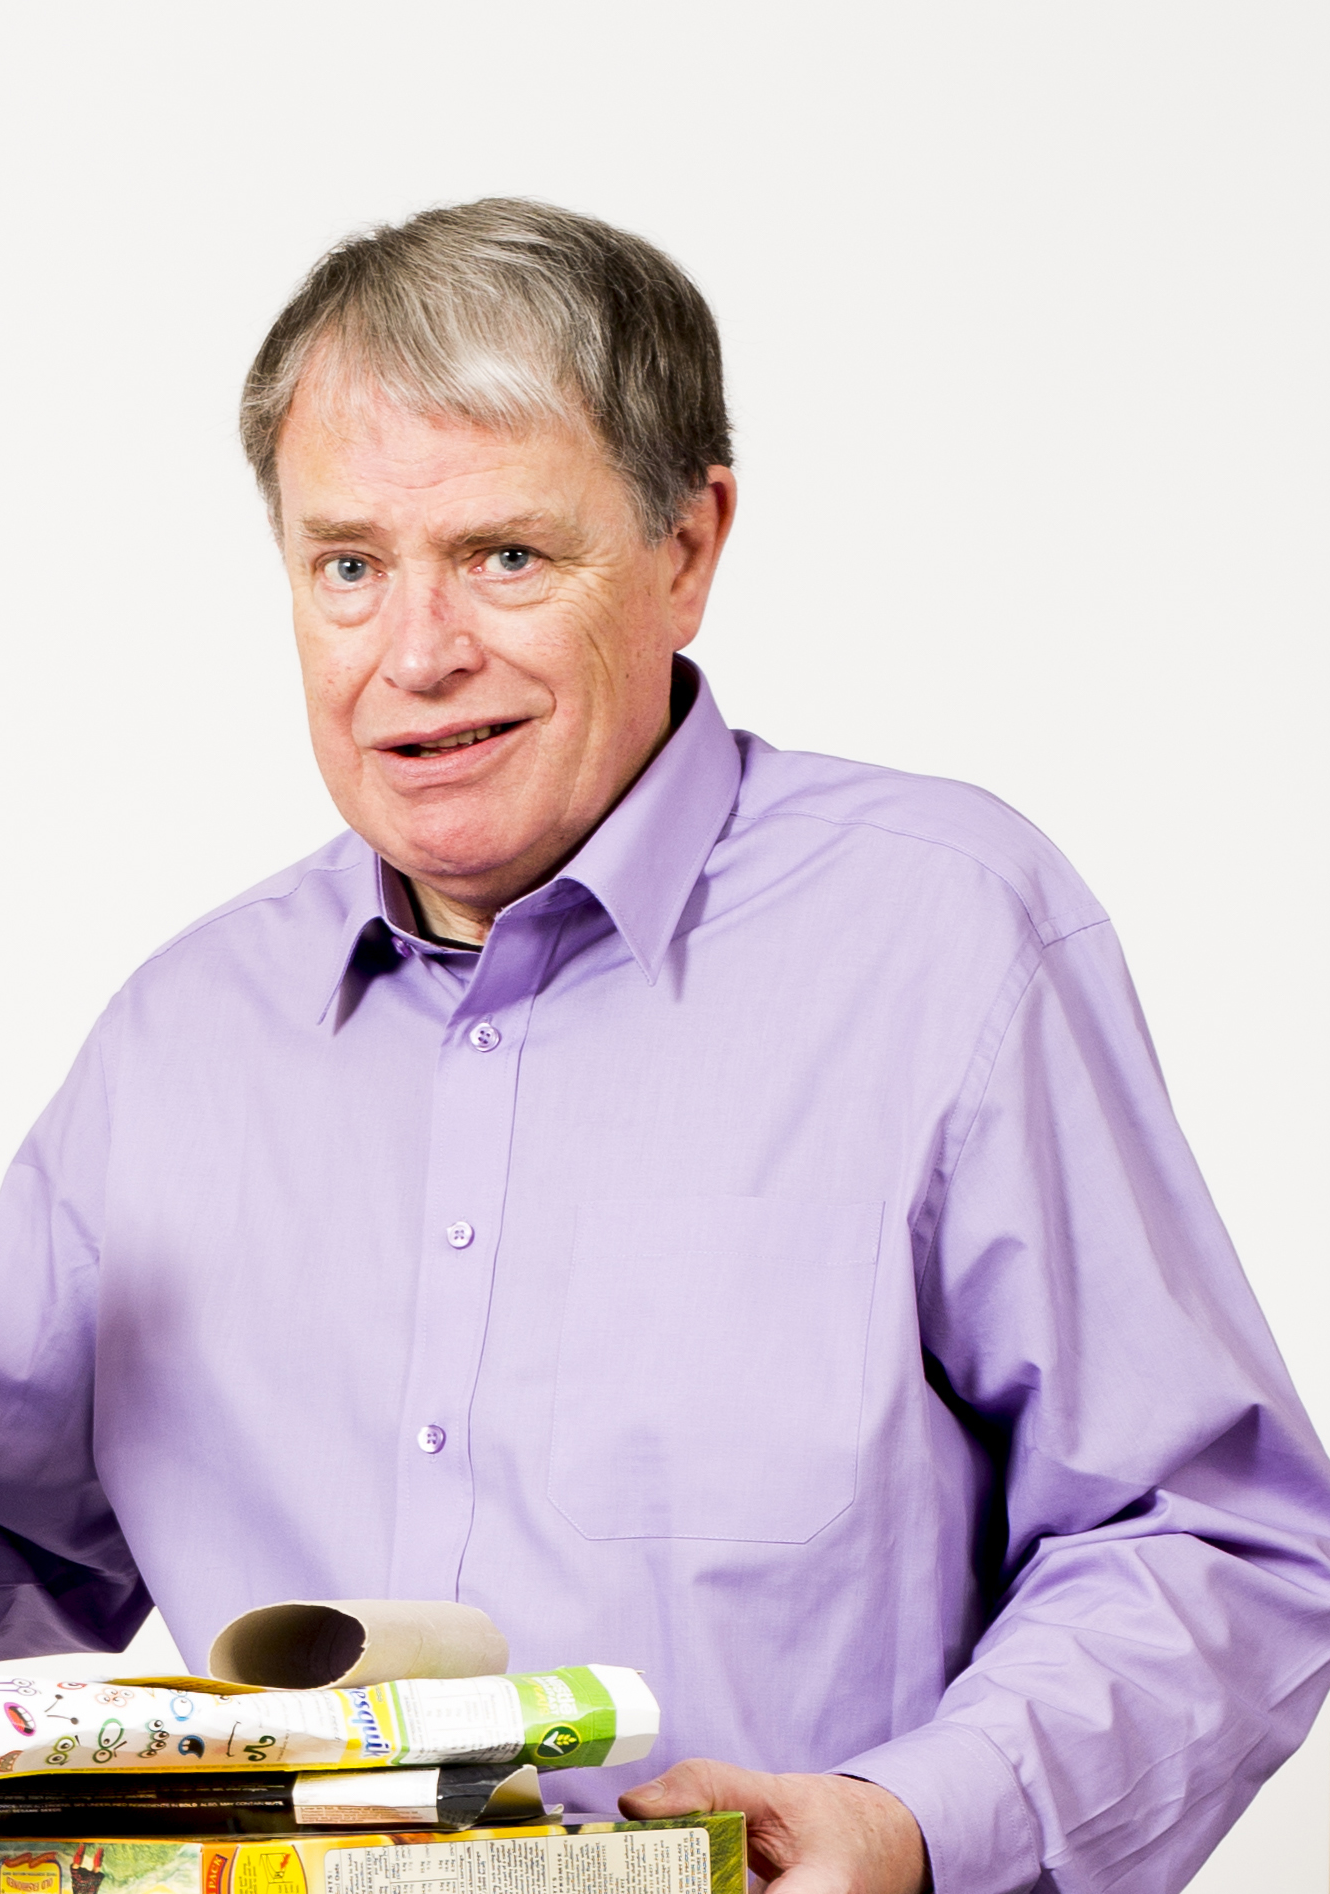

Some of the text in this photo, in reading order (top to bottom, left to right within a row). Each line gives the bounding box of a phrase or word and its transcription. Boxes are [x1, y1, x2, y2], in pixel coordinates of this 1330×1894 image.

[5, 1875, 52, 1891] OLD FASHIONED
[208, 1855, 222, 1888] PACK
